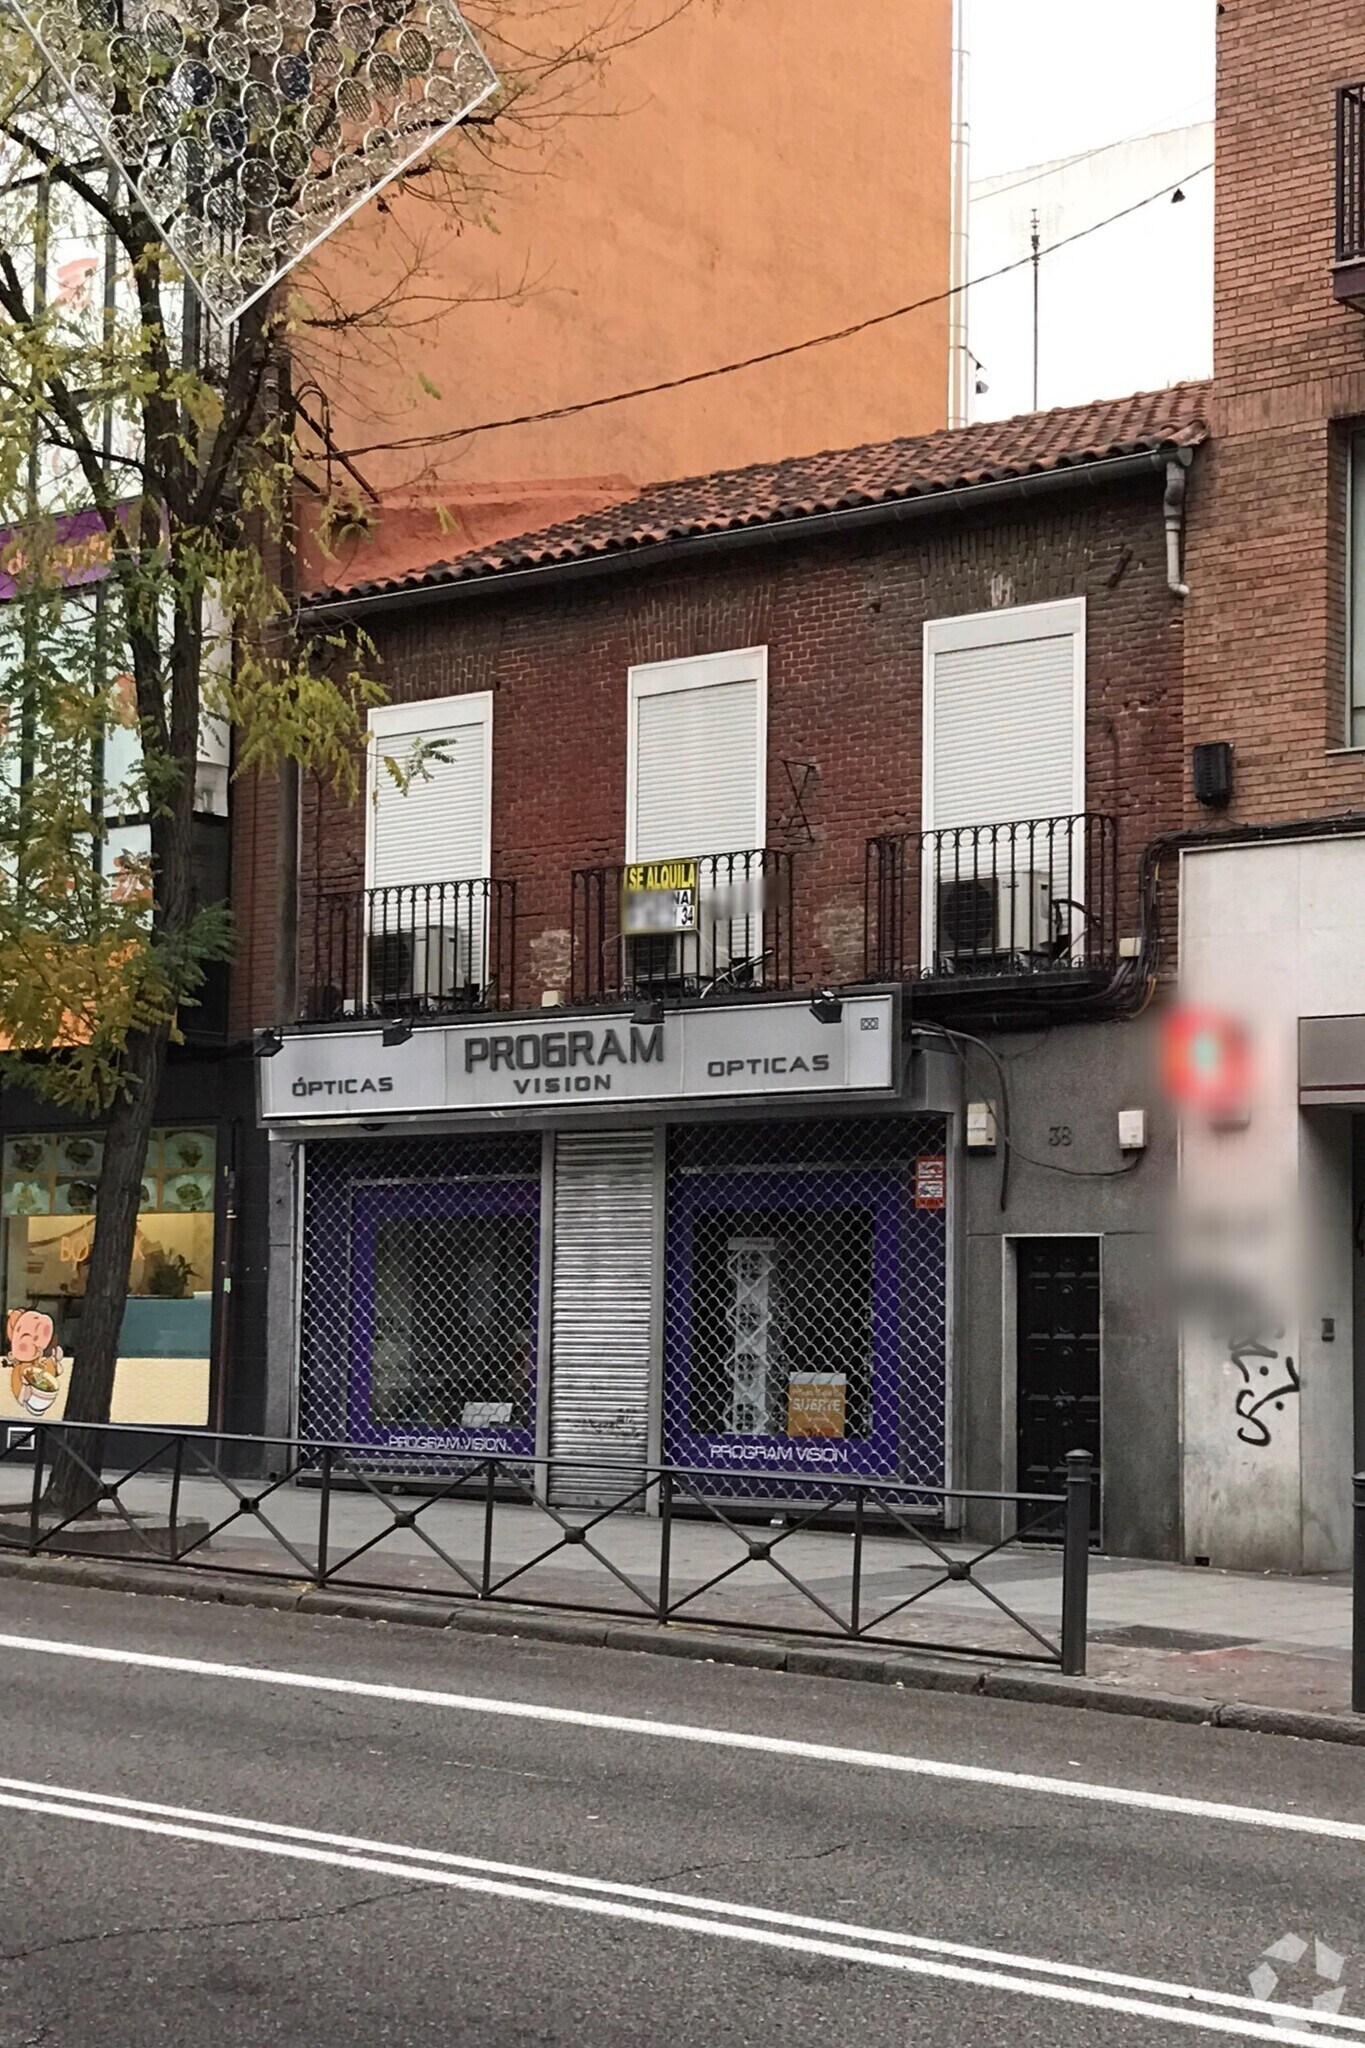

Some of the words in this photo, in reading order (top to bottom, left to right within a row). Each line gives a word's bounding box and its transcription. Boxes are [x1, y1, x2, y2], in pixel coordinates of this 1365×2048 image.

[629, 866, 644, 890] SE
[646, 863, 695, 888] ALQUILA
[464, 1025, 665, 1073] PROGRAM
[707, 1054, 829, 1077] OPTICAS
[292, 1076, 393, 1097] ÓPTICAS
[513, 1074, 611, 1095] VISION
[1048, 1126, 1072, 1147] 38
[710, 1445, 793, 1460] PROGRAM
[796, 1448, 847, 1462] VISION
